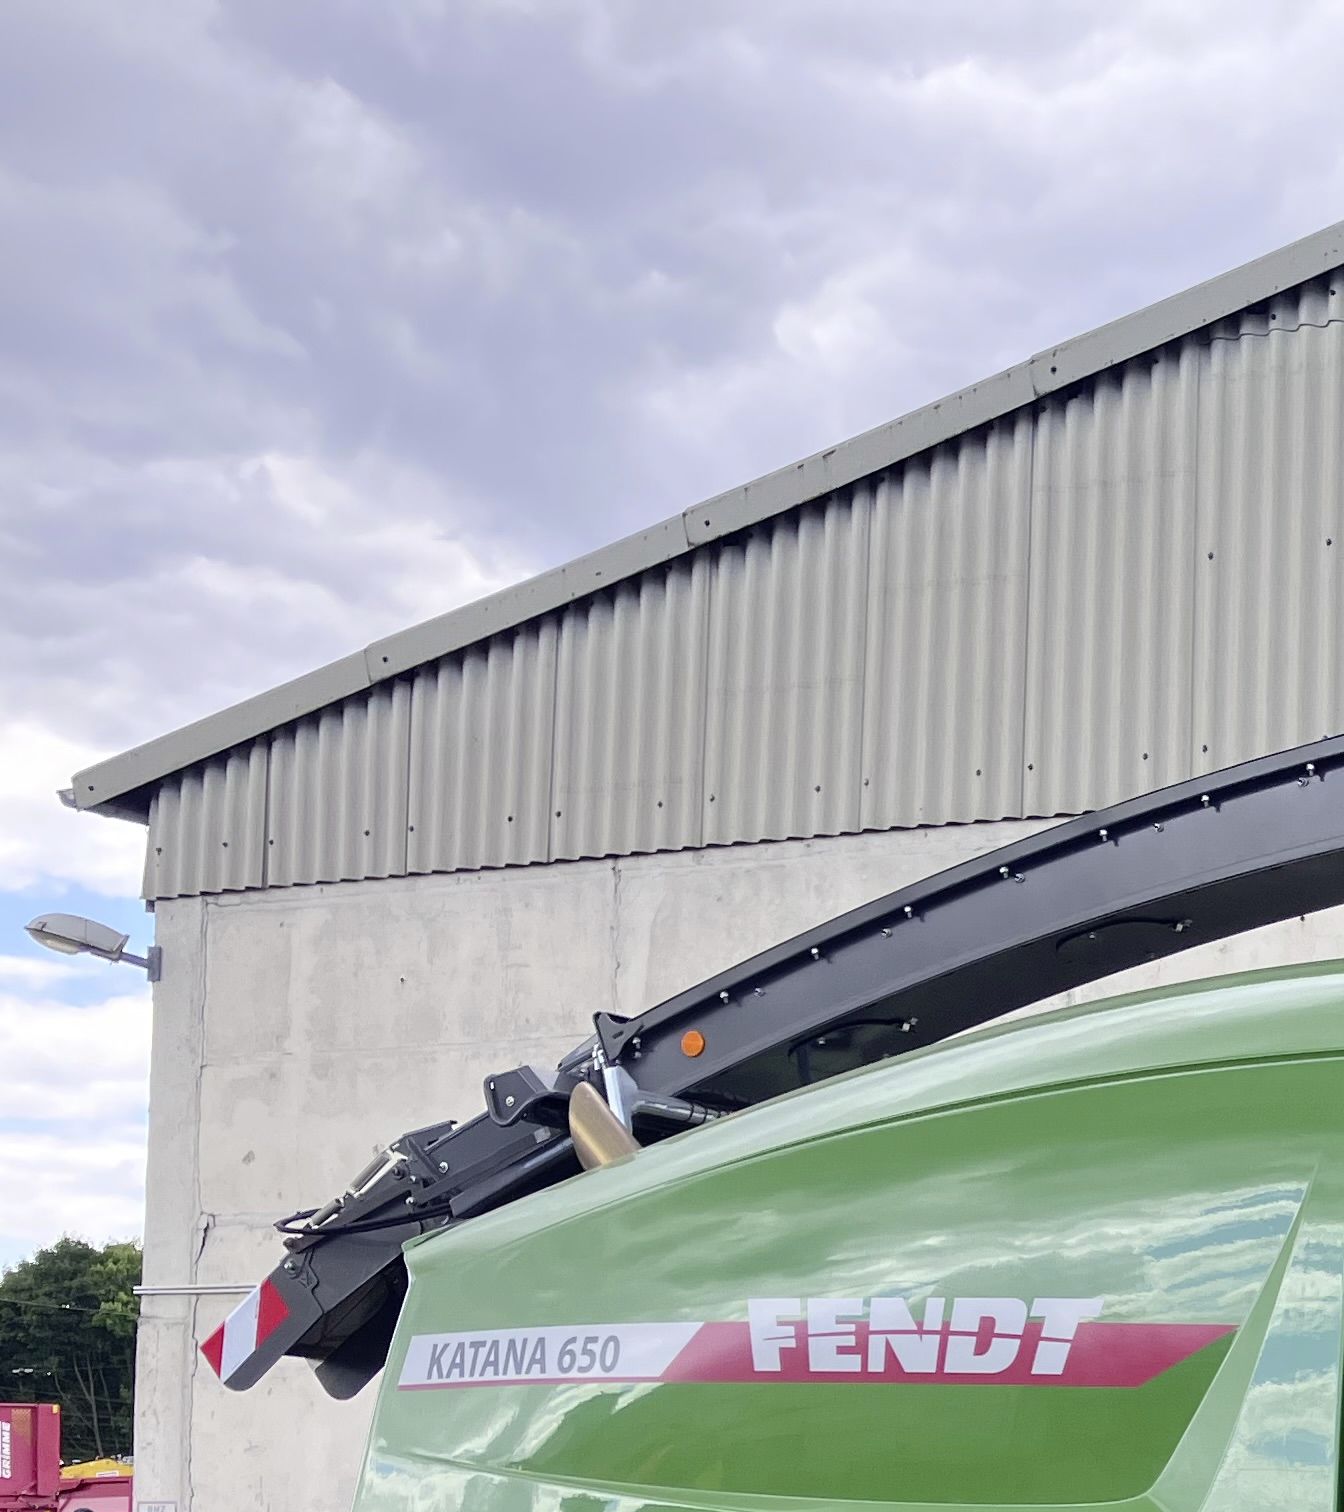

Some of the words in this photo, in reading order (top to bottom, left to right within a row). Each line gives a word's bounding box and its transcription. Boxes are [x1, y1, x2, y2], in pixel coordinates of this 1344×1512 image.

[427, 1336, 547, 1380] KATANA
[557, 1335, 620, 1374] 650
[748, 1297, 1104, 1375] FENDT
[1, 1421, 12, 1479] GRIMME
